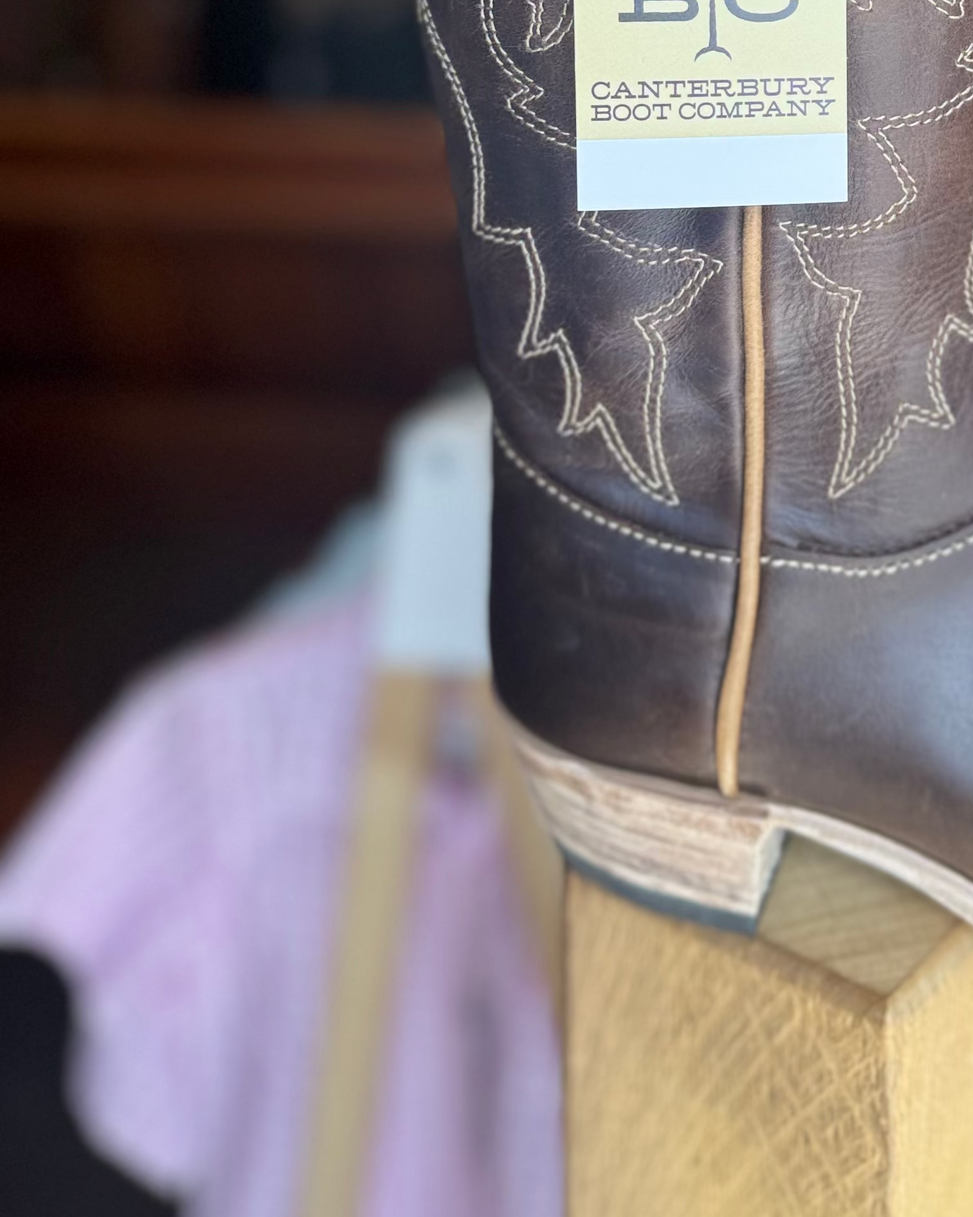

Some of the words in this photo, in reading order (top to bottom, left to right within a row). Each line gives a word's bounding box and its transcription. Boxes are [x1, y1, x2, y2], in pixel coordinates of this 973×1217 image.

[591, 77, 836, 100] CANTERBURY
[591, 103, 672, 122] BOOT
[677, 99, 837, 121] COMPANY
